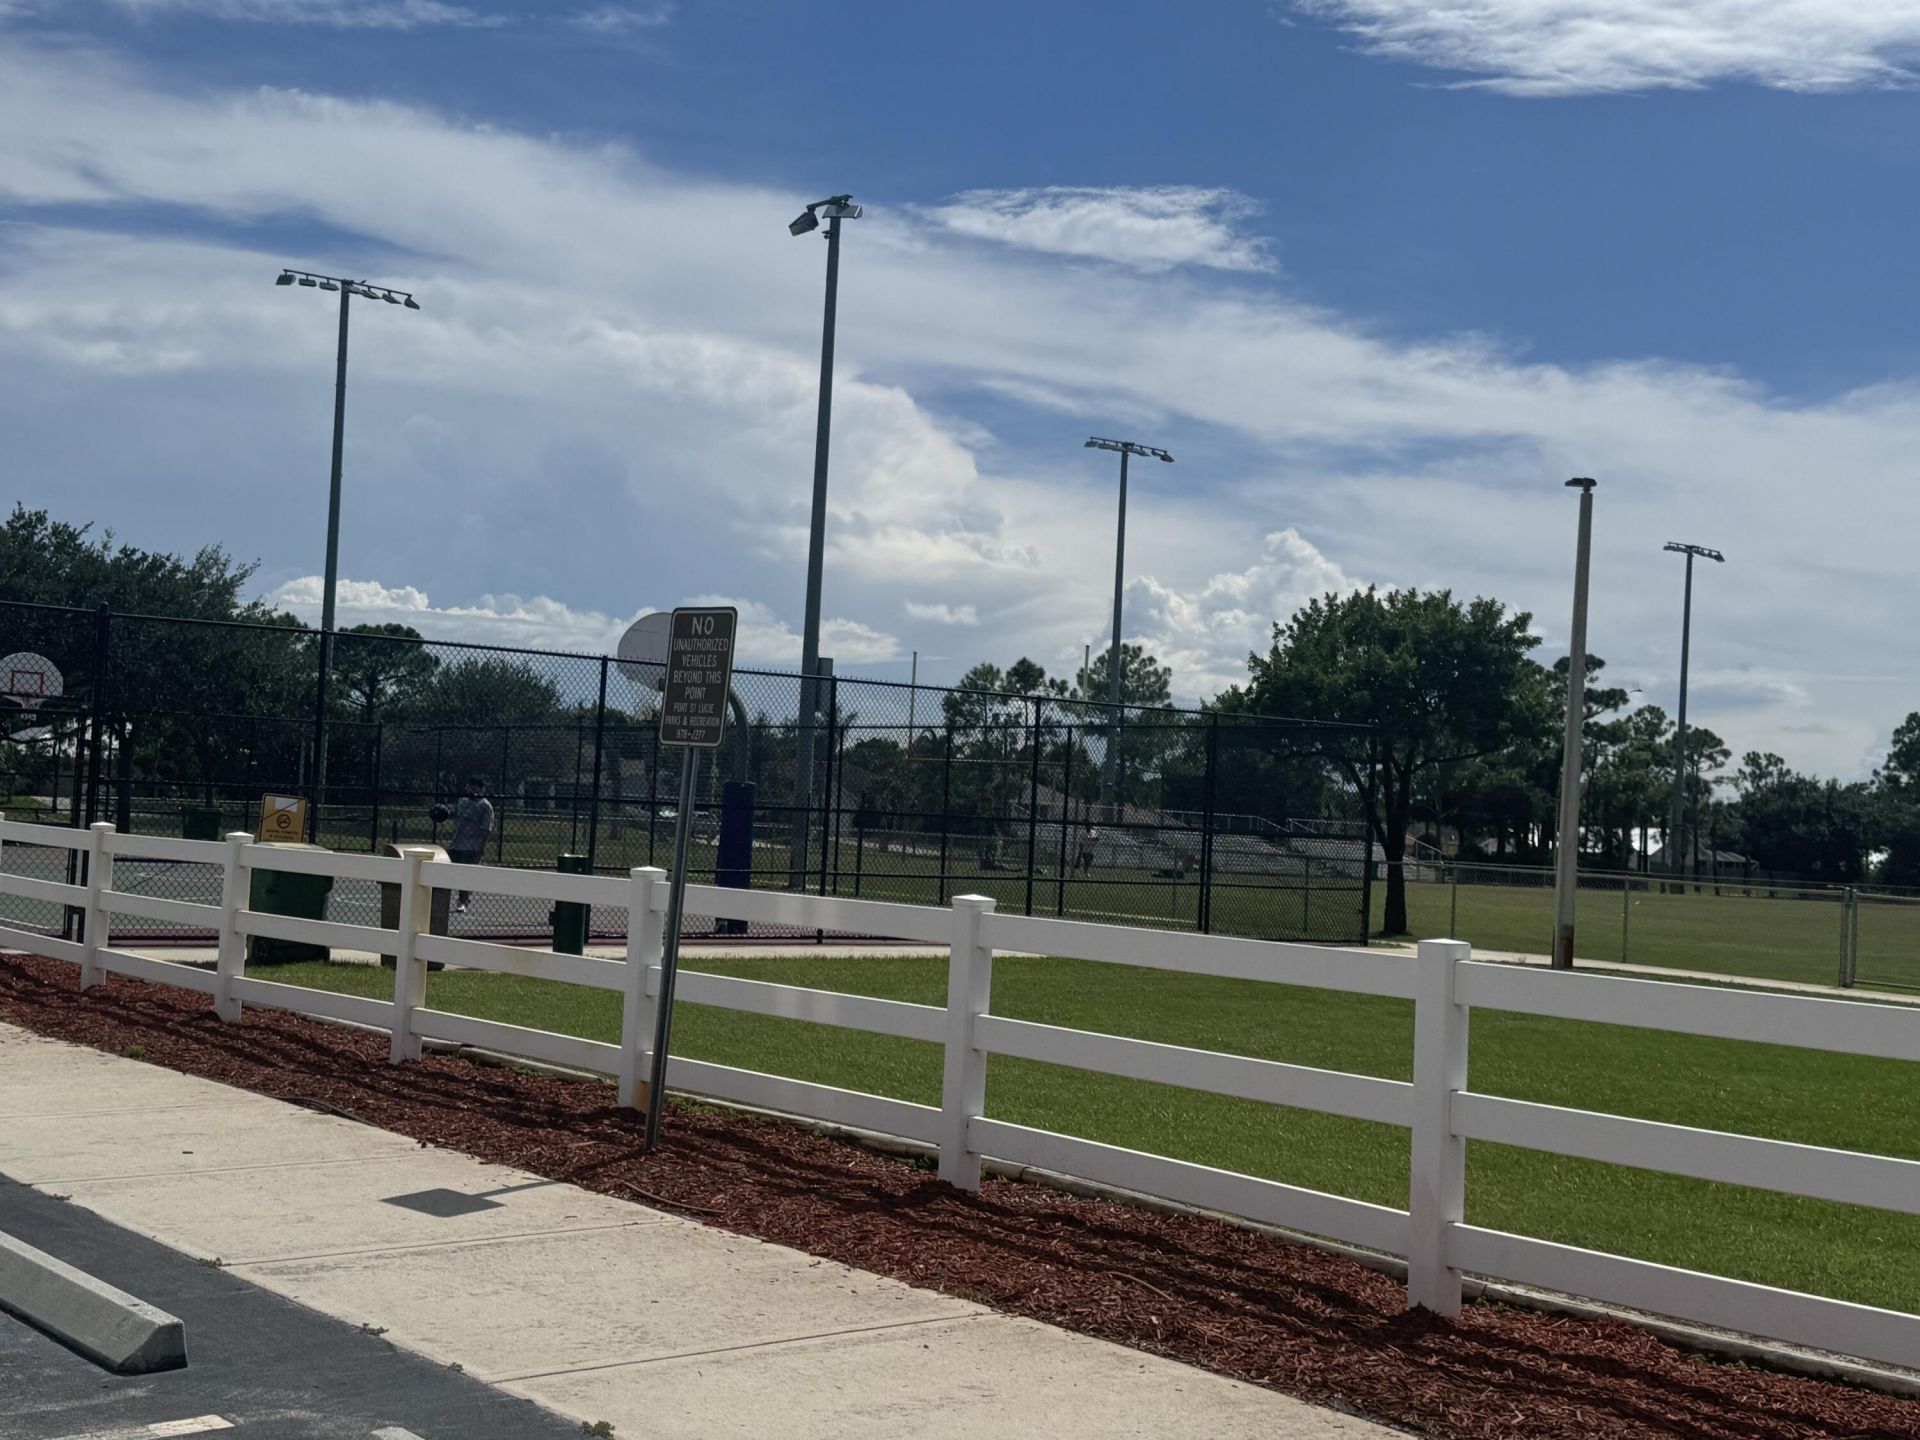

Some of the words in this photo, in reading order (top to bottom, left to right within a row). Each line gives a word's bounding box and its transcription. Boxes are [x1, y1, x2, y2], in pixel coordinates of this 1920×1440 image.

[691, 616, 714, 635] NO
[673, 638, 729, 651] UNAUTHORIZED
[682, 654, 717, 667] VEHICLES
[673, 671, 702, 683] BEYOND
[705, 671, 721, 684] THIS
[684, 687, 706, 699] POINT
[673, 702, 688, 713] PORT
[698, 703, 714, 713] LUCIE
[665, 715, 681, 725] PARKS
[682, 716, 688, 726] &
[689, 716, 720, 727] RECREATION
